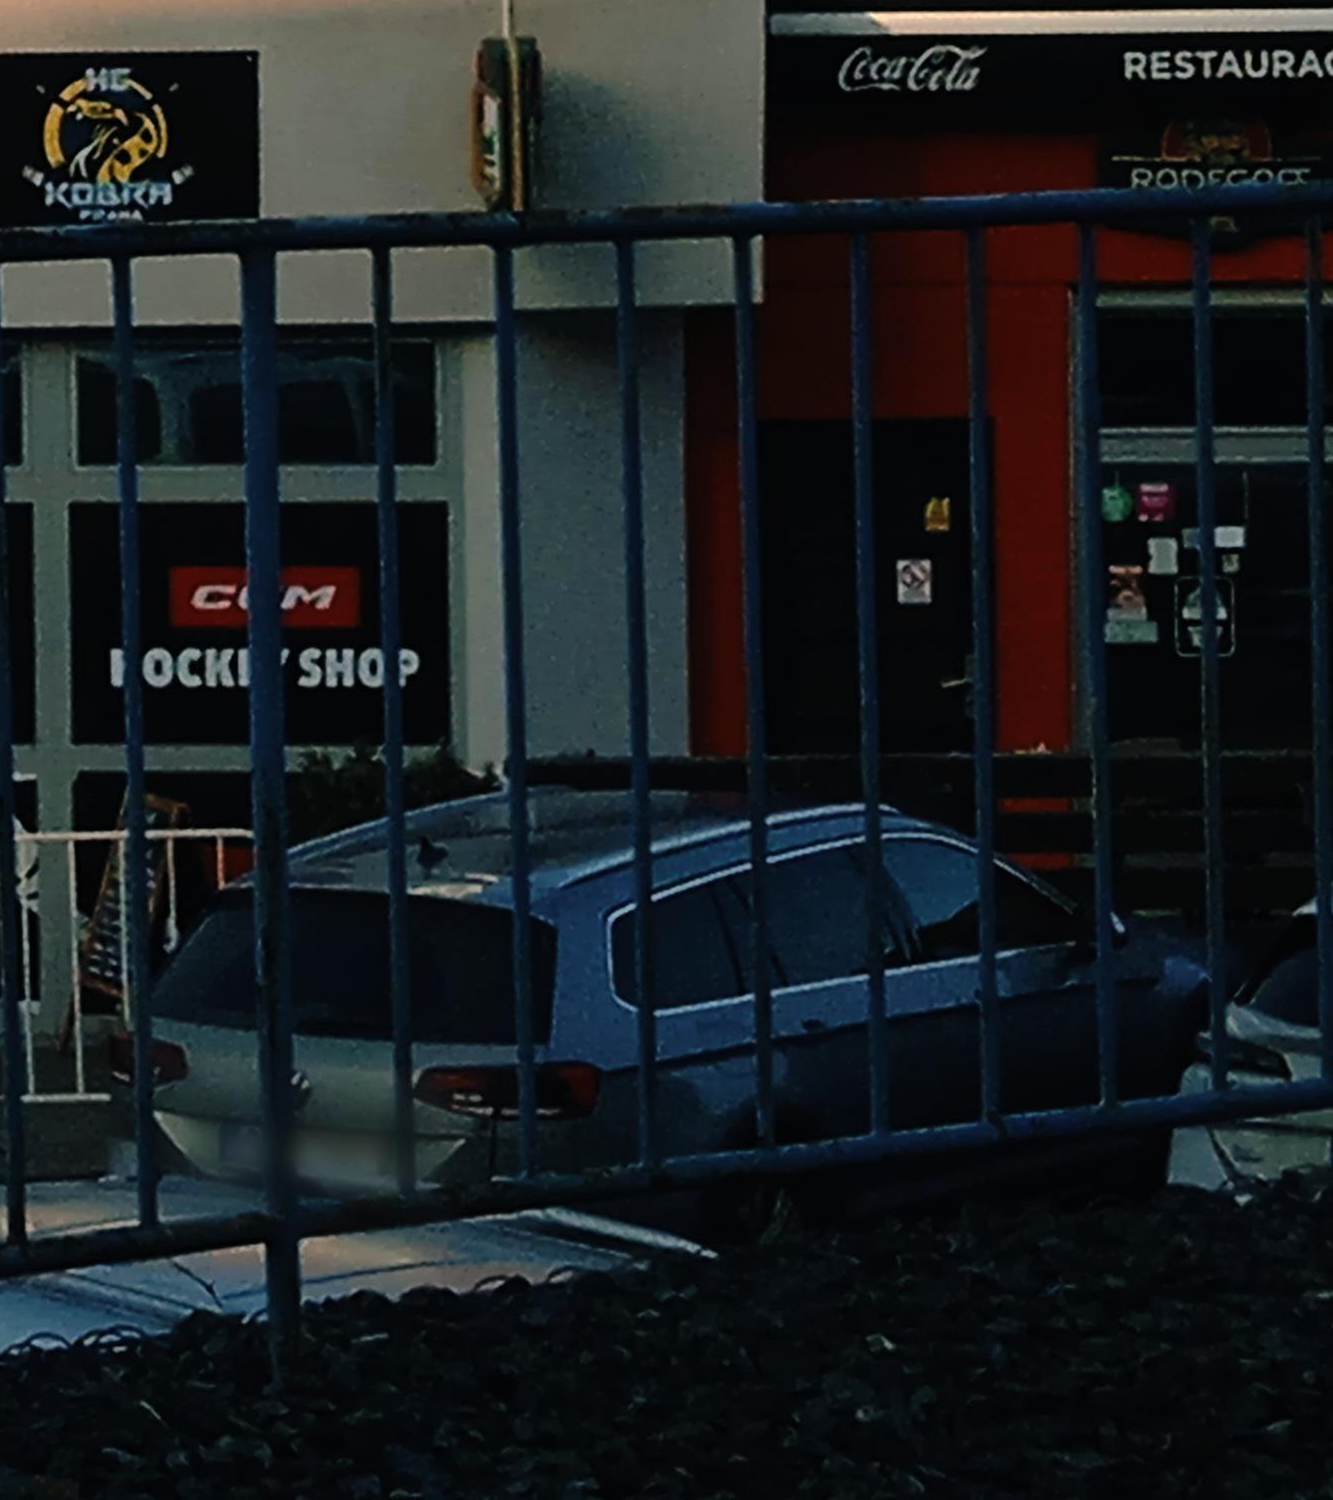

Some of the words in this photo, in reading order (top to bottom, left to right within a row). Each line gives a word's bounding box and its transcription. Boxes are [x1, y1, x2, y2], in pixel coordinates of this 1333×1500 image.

[85, 67, 132, 92] HC
[44, 181, 173, 209] KOBRA
[109, 647, 290, 688] OCK
[297, 647, 420, 688] SHOP
